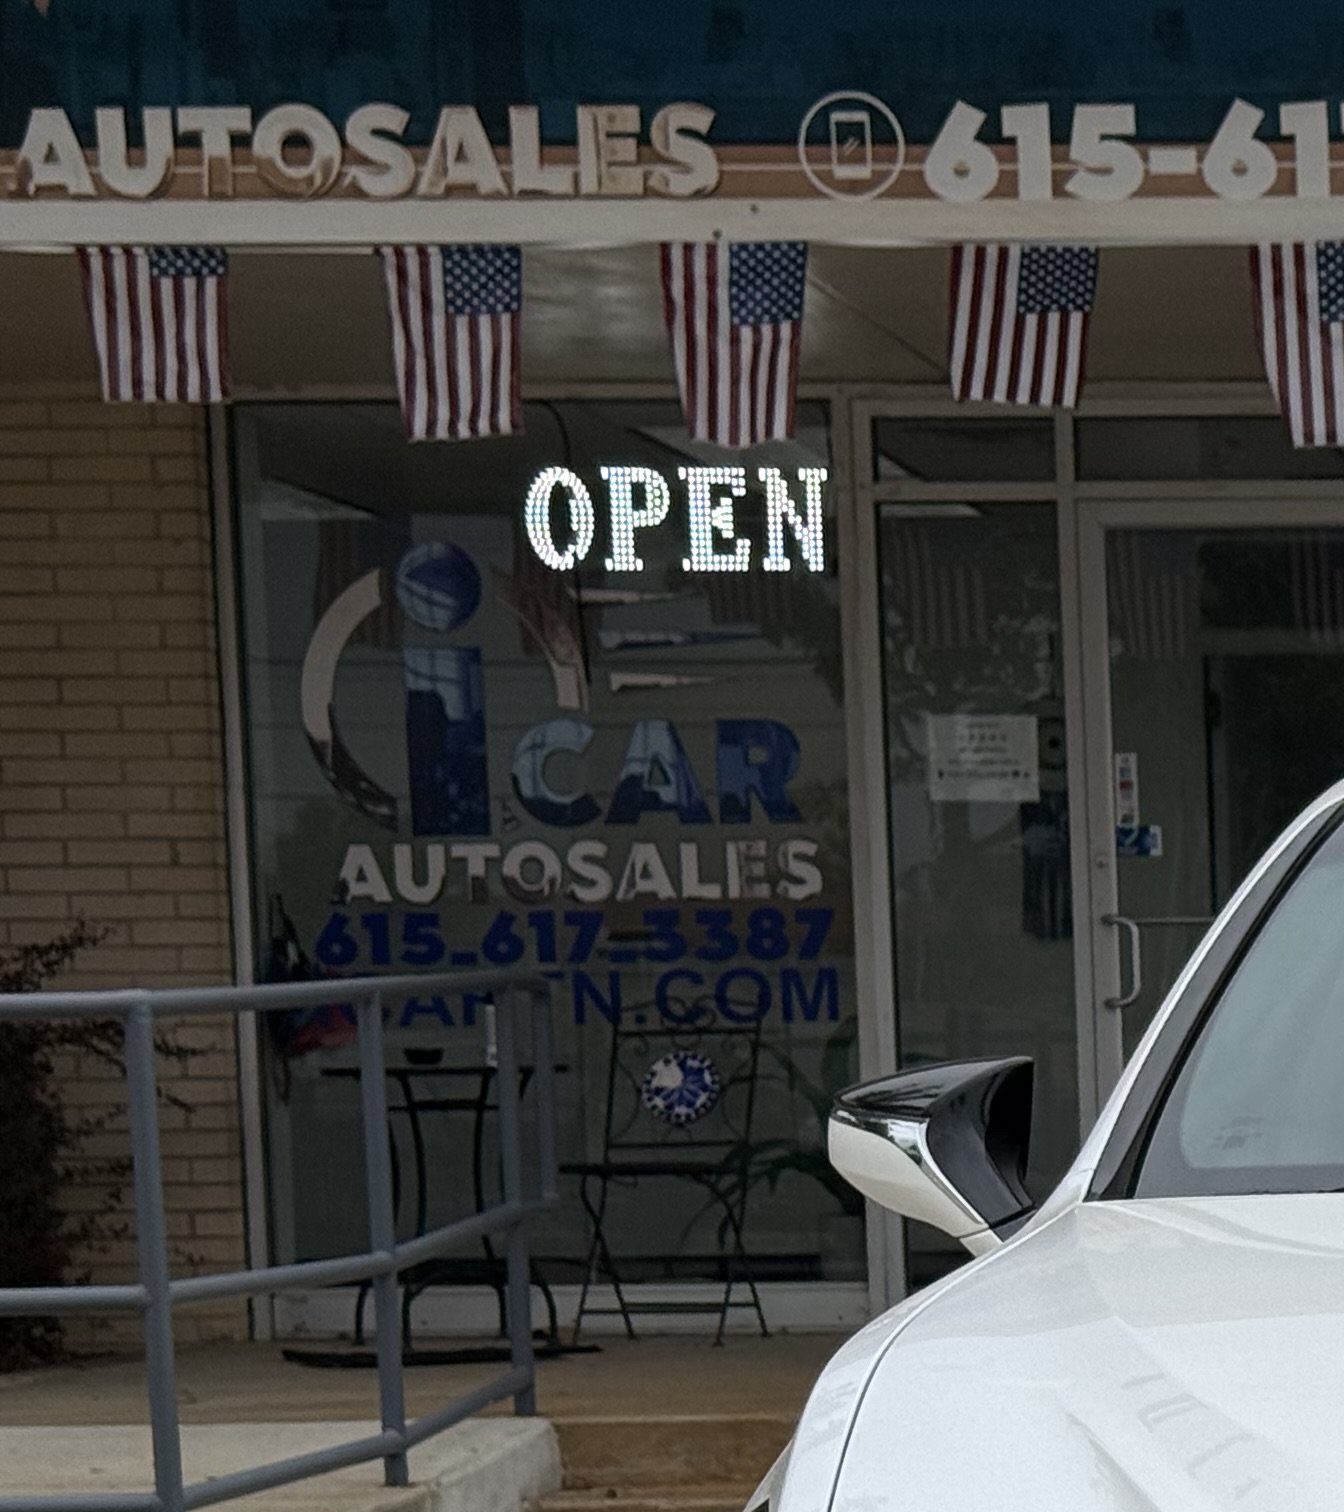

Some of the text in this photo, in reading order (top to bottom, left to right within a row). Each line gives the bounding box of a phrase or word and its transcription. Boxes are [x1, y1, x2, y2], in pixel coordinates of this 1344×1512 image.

[10, 102, 719, 198] AUTOSALES
[524, 465, 828, 573] OPEN
[332, 839, 825, 905] AUTOSALES
